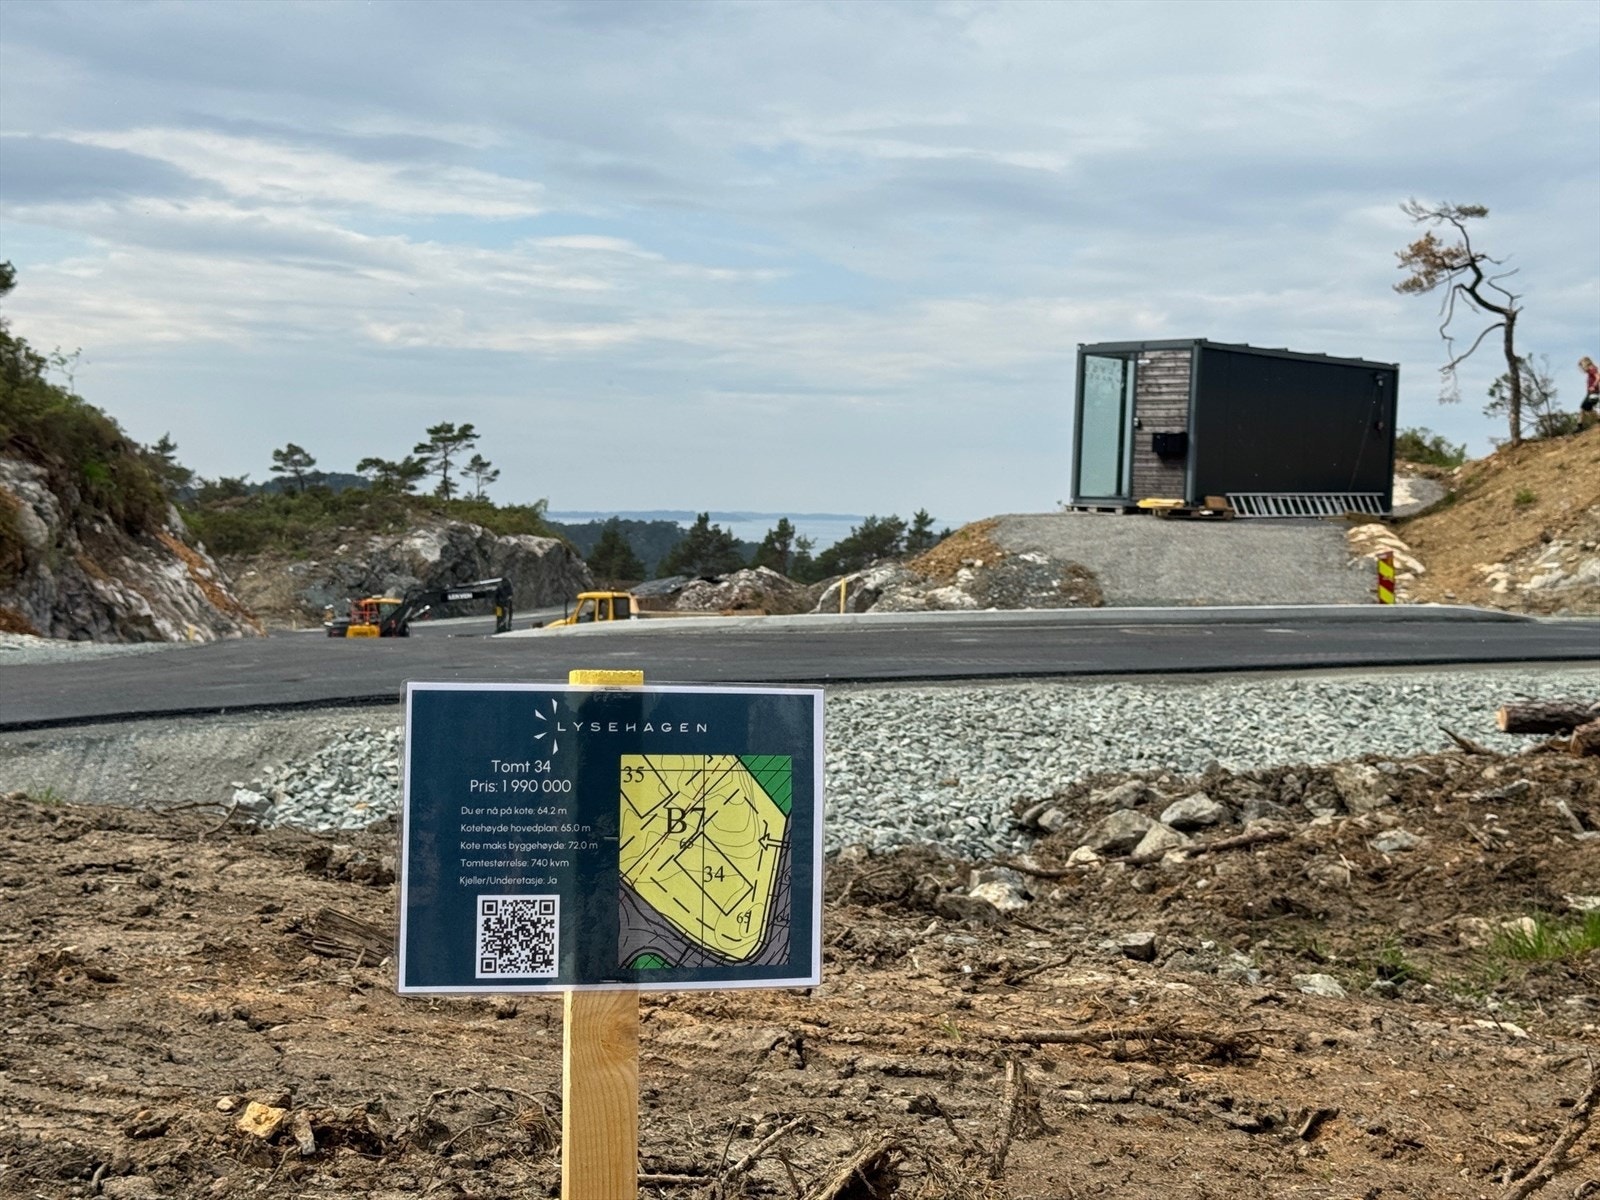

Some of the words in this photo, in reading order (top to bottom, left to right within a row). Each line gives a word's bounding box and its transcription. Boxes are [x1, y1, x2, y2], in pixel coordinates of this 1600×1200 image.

[557, 721, 708, 733] LYSEHAGEN
[491, 760, 531, 773] Tomt
[534, 760, 551, 773] 34
[622, 765, 645, 783] 35
[470, 779, 498, 793] Pris:
[511, 779, 538, 793] 990
[542, 779, 572, 793] 000
[461, 806, 473, 815] Du
[487, 806, 498, 815] nå
[500, 806, 513, 818] på
[514, 806, 536, 815] kote:
[663, 806, 706, 834] B7
[460, 823, 509, 834] Kotehøyde
[460, 841, 481, 850] Kote
[482, 841, 507, 850] maks
[508, 841, 566, 852] byggehøyde:
[530, 858, 549, 867] 740
[549, 858, 570, 867] kvm
[703, 865, 725, 883] 34
[459, 876, 545, 887] Kjeller/Underetasje:
[546, 876, 558, 885] Ja
